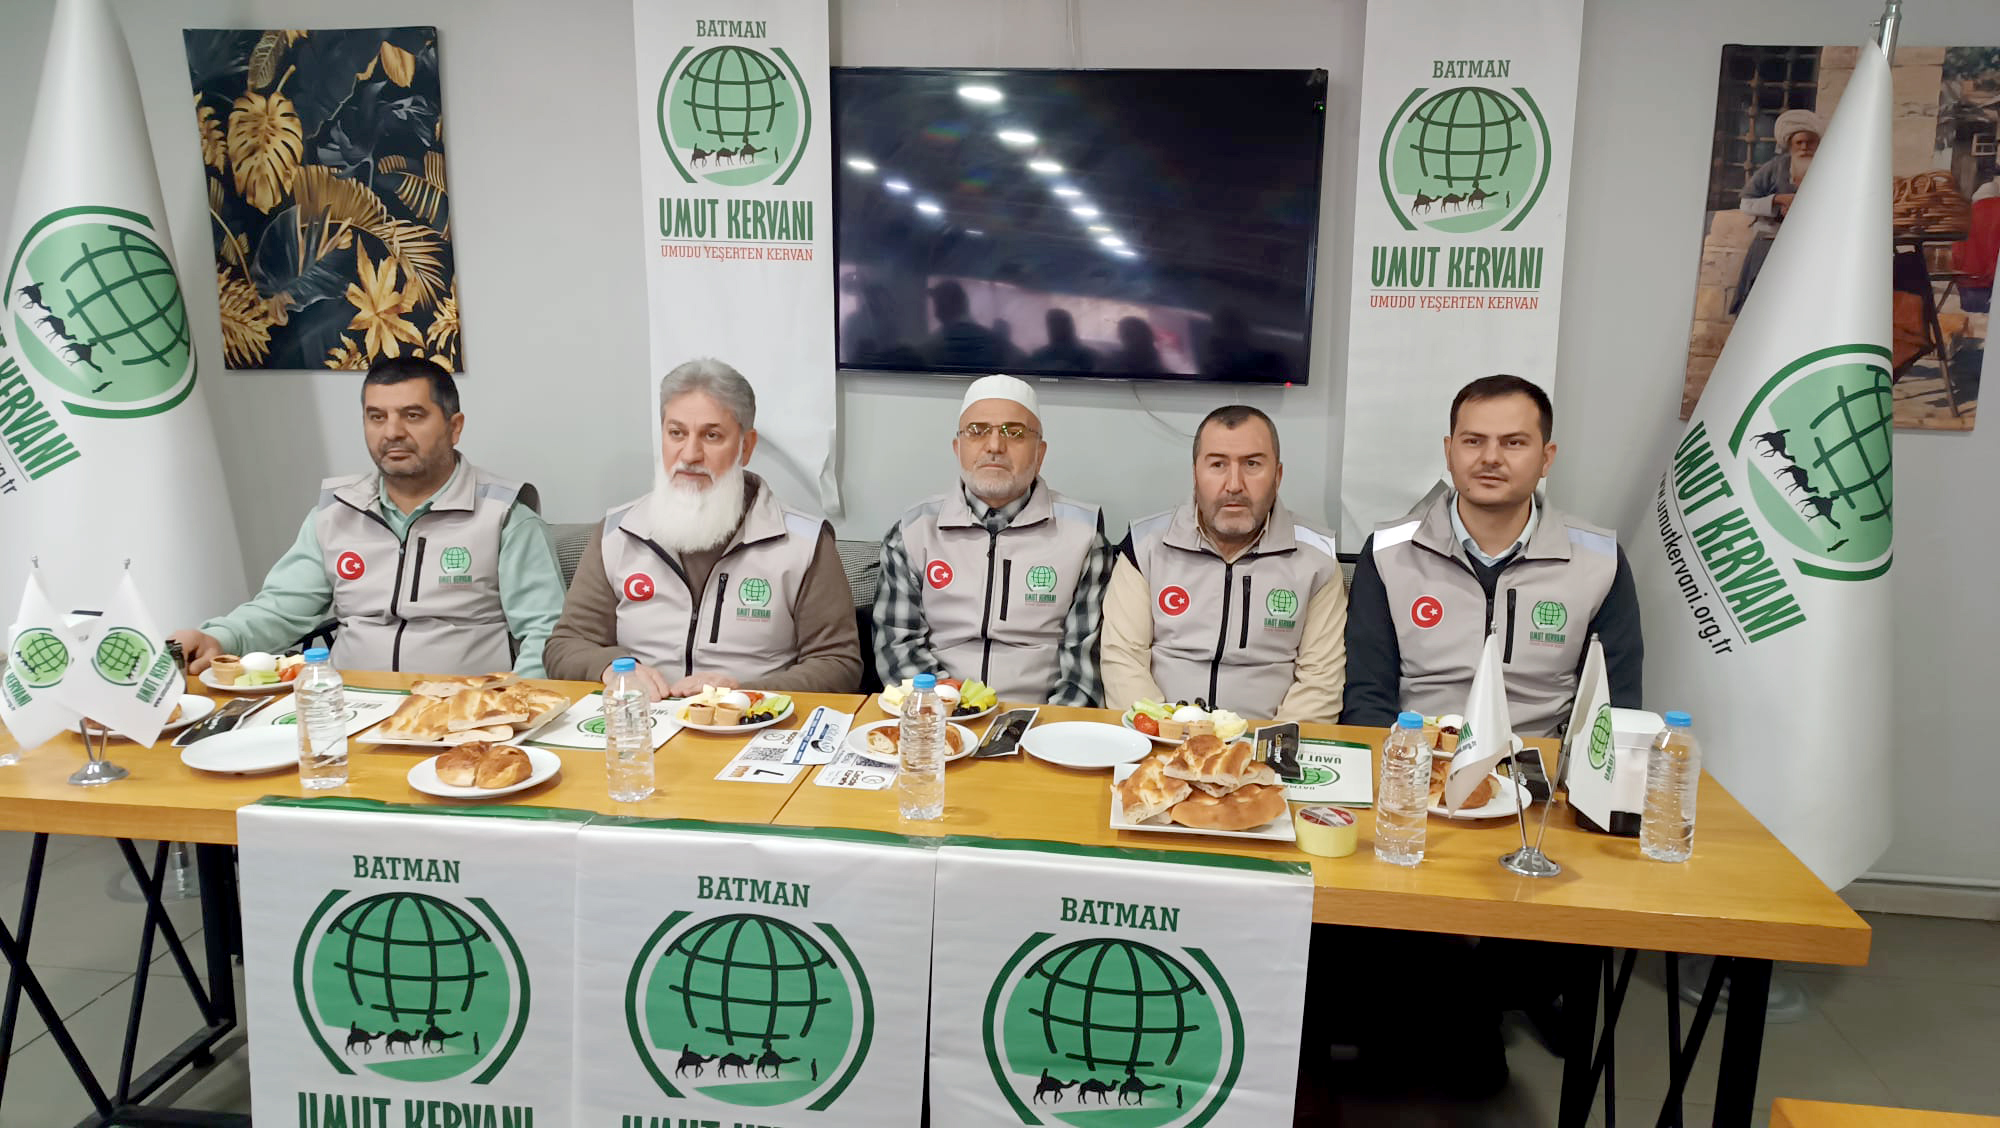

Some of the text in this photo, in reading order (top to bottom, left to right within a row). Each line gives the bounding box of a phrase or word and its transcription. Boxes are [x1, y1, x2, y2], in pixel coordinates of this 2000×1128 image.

[696, 20, 767, 38] BATMAN
[1432, 60, 1511, 79] BATMAN
[659, 198, 813, 241] UMUT KERVANI
[661, 245, 813, 263] UMUDU YEŞERTEN KERVAN
[1371, 246, 1543, 289] UMUT KERVANI
[1370, 296, 1539, 313] UMUDU YEŞERTEN KERVAN
[1674, 420, 1807, 644] UMUT KERVANI
[352, 855, 461, 884] BATMAN
[697, 876, 810, 908] BATMAN
[1060, 896, 1181, 933] BATMAN
